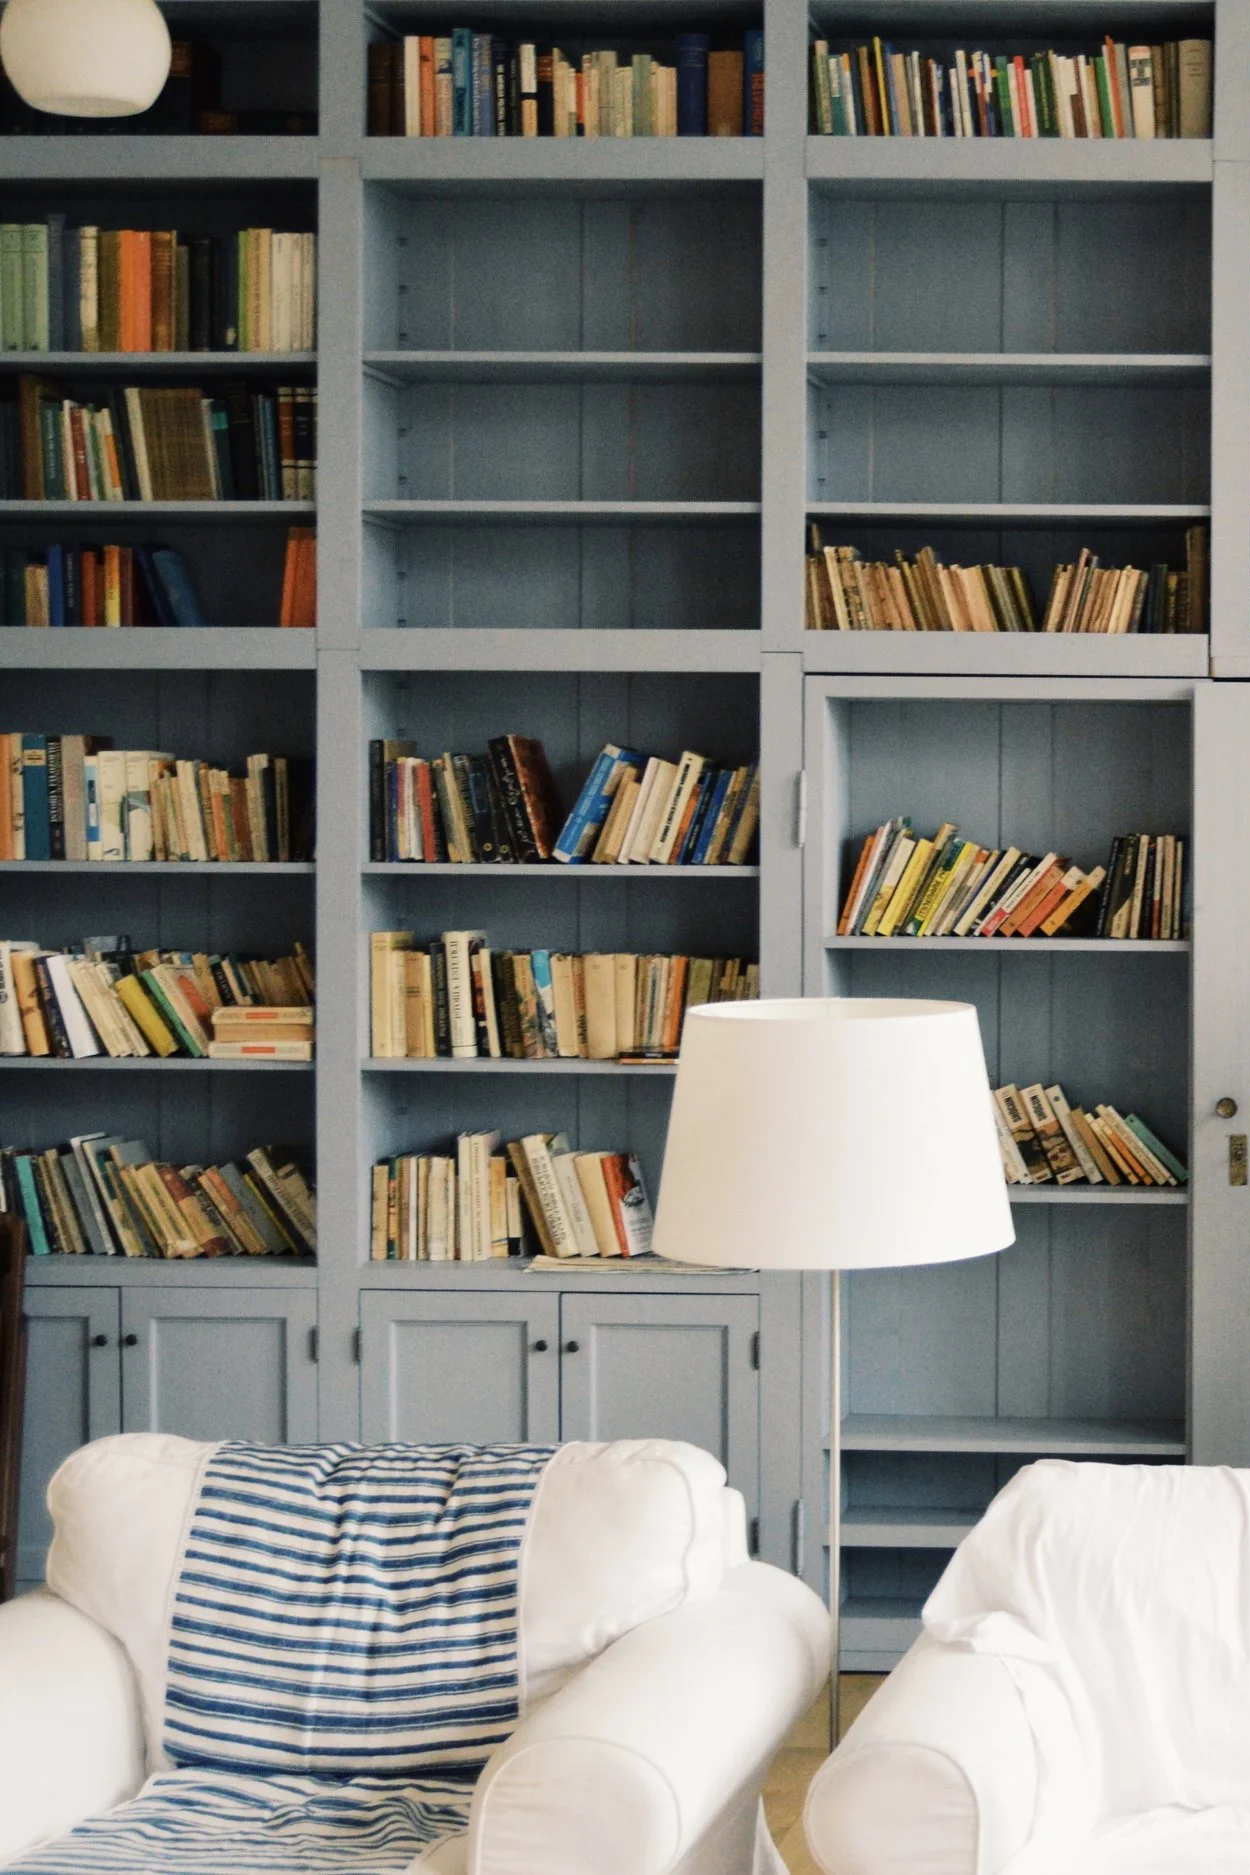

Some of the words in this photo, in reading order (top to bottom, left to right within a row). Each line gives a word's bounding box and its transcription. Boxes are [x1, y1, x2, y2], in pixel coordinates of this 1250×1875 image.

[48, 790, 57, 822] ISTORIA
[452, 985, 462, 1019] ISTORIA
[1004, 1096, 1022, 1124] SHOGUN
[1029, 1095, 1047, 1122] SHOGUN
